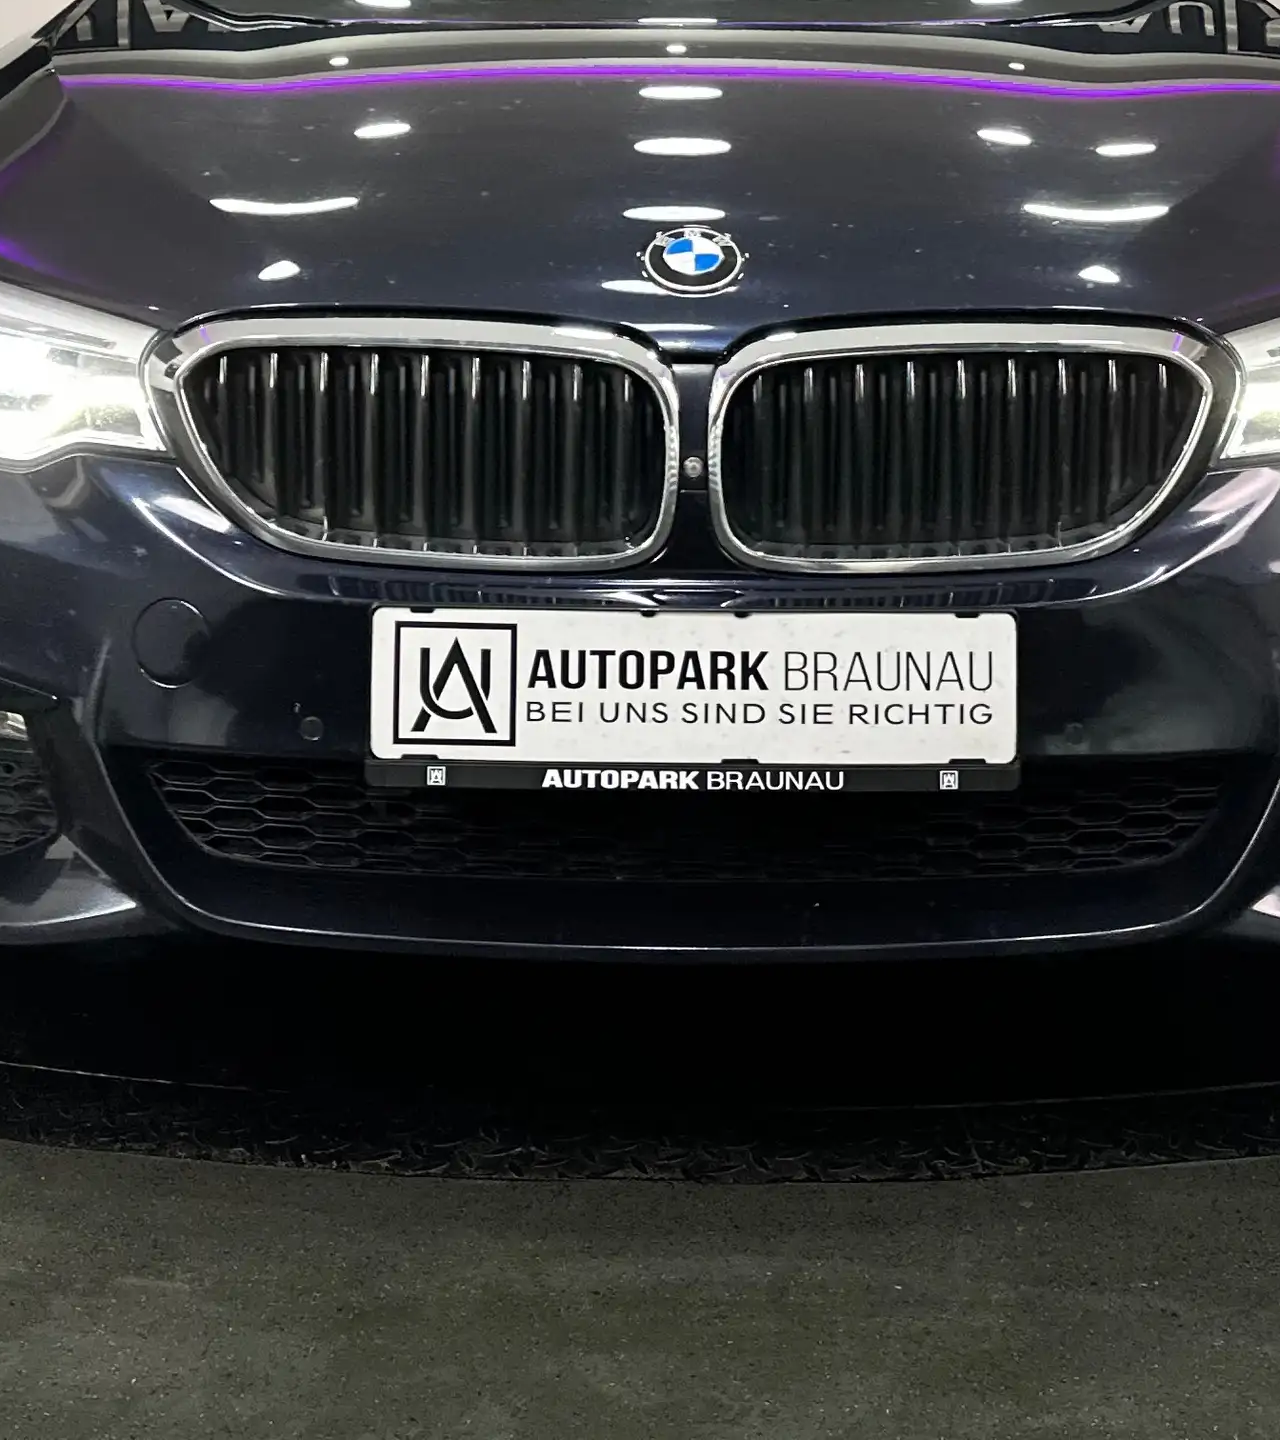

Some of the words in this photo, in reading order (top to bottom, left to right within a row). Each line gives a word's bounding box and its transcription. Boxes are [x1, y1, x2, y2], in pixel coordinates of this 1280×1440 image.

[527, 648, 770, 692] AUTOPARK
[783, 651, 994, 693] BRAUNAU
[526, 701, 584, 724] BEI
[600, 701, 669, 725] UNS
[681, 702, 766, 725] SIND
[778, 702, 834, 725] SIE
[847, 702, 994, 726] RICHTIG
[542, 769, 700, 791] AUTOPARK
[707, 770, 845, 792] BRAUNAU
